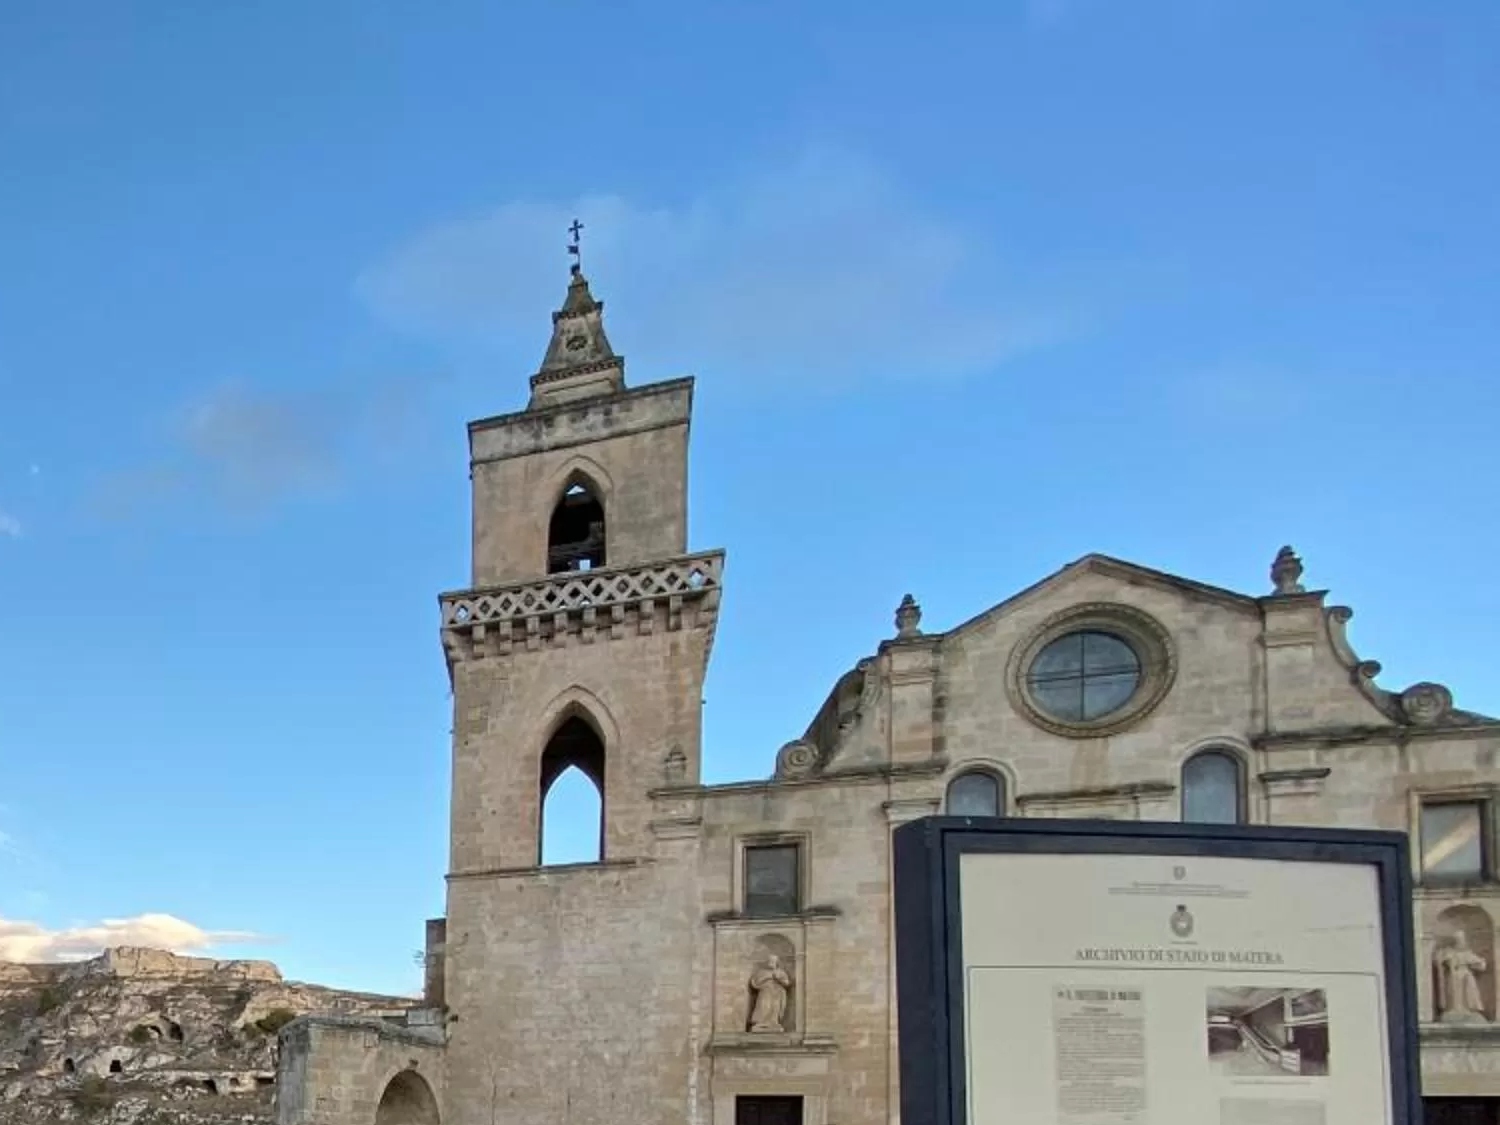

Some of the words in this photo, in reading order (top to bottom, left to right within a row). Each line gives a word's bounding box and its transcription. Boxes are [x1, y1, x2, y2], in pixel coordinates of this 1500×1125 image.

[1076, 947, 1146, 961] ARCHIVIO
[1150, 948, 1163, 961] DI
[1228, 951, 1284, 965] MATERA
